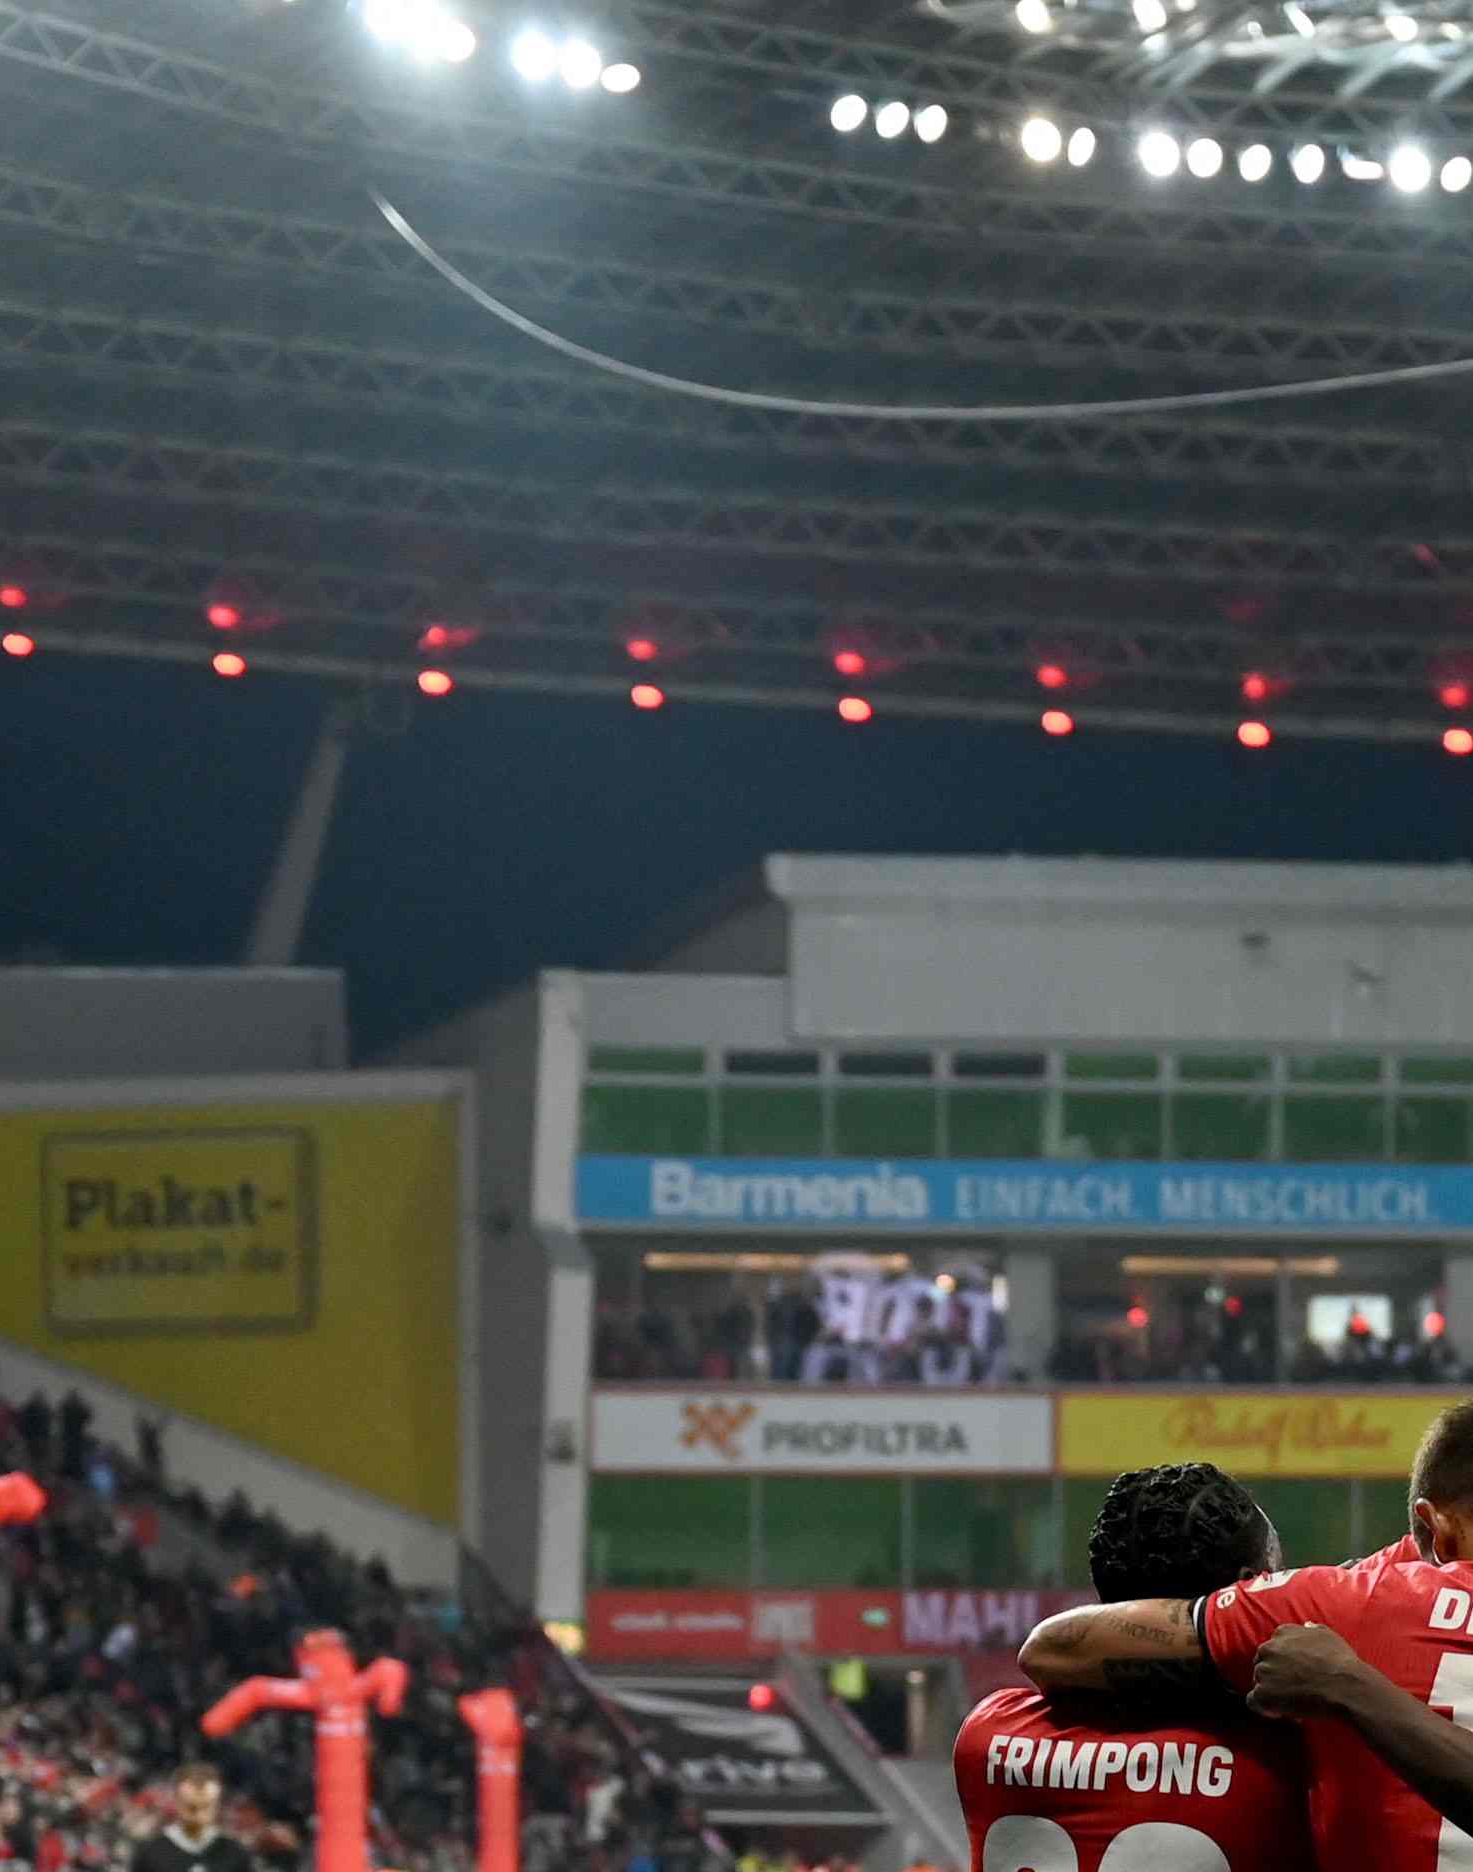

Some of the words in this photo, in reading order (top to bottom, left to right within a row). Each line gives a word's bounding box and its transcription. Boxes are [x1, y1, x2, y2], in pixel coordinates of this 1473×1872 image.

[63, 1174, 288, 1232] Plakat-
[650, 1161, 927, 1218] Barmenia
[956, 1175, 1135, 1219] EINFACH.
[1160, 1178, 1437, 1223] MENSCHLICH.
[762, 1421, 969, 1456] PROFILTRA
[985, 1734, 1234, 1798] FRIMPONG
